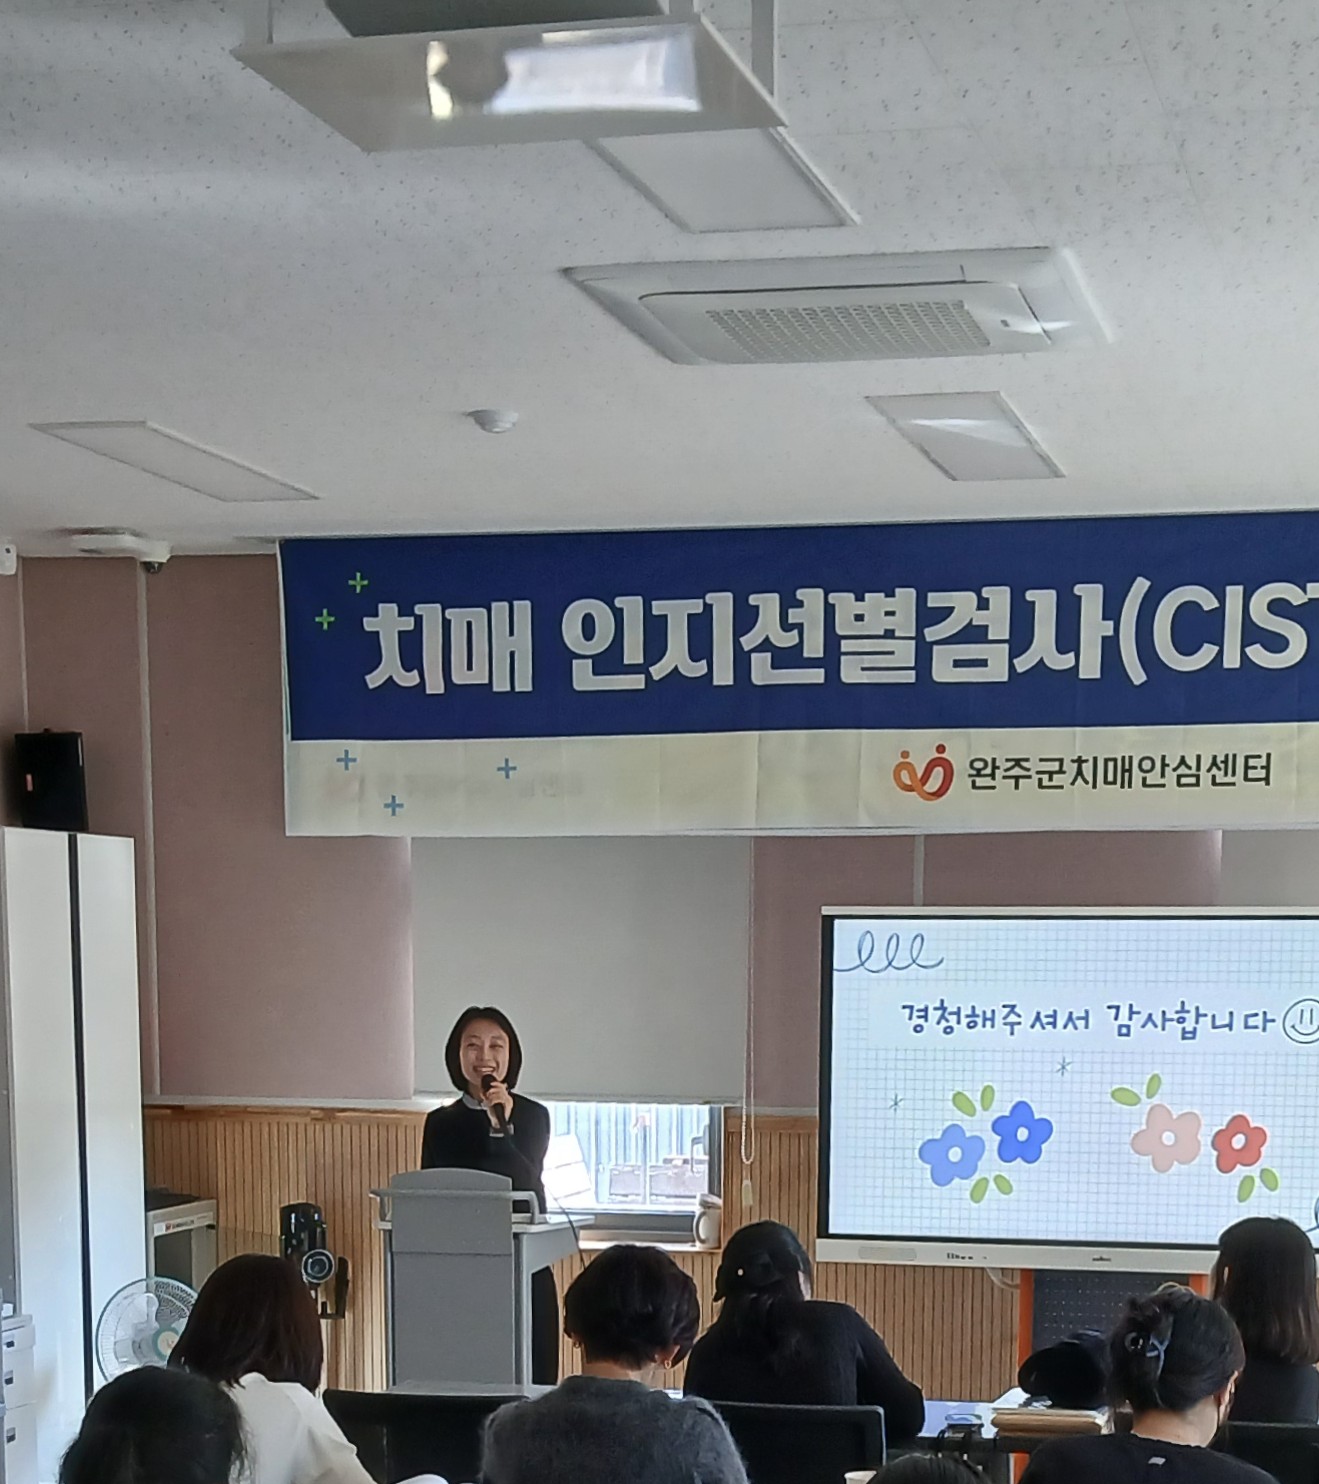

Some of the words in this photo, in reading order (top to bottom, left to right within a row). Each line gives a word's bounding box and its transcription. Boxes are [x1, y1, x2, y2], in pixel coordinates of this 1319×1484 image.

[362, 598, 534, 695] 치매
[967, 752, 1273, 791] 완주군치매안심센터
[901, 999, 1091, 1036] 경청해주셔서
[1106, 1000, 1277, 1041] 감사합니다
